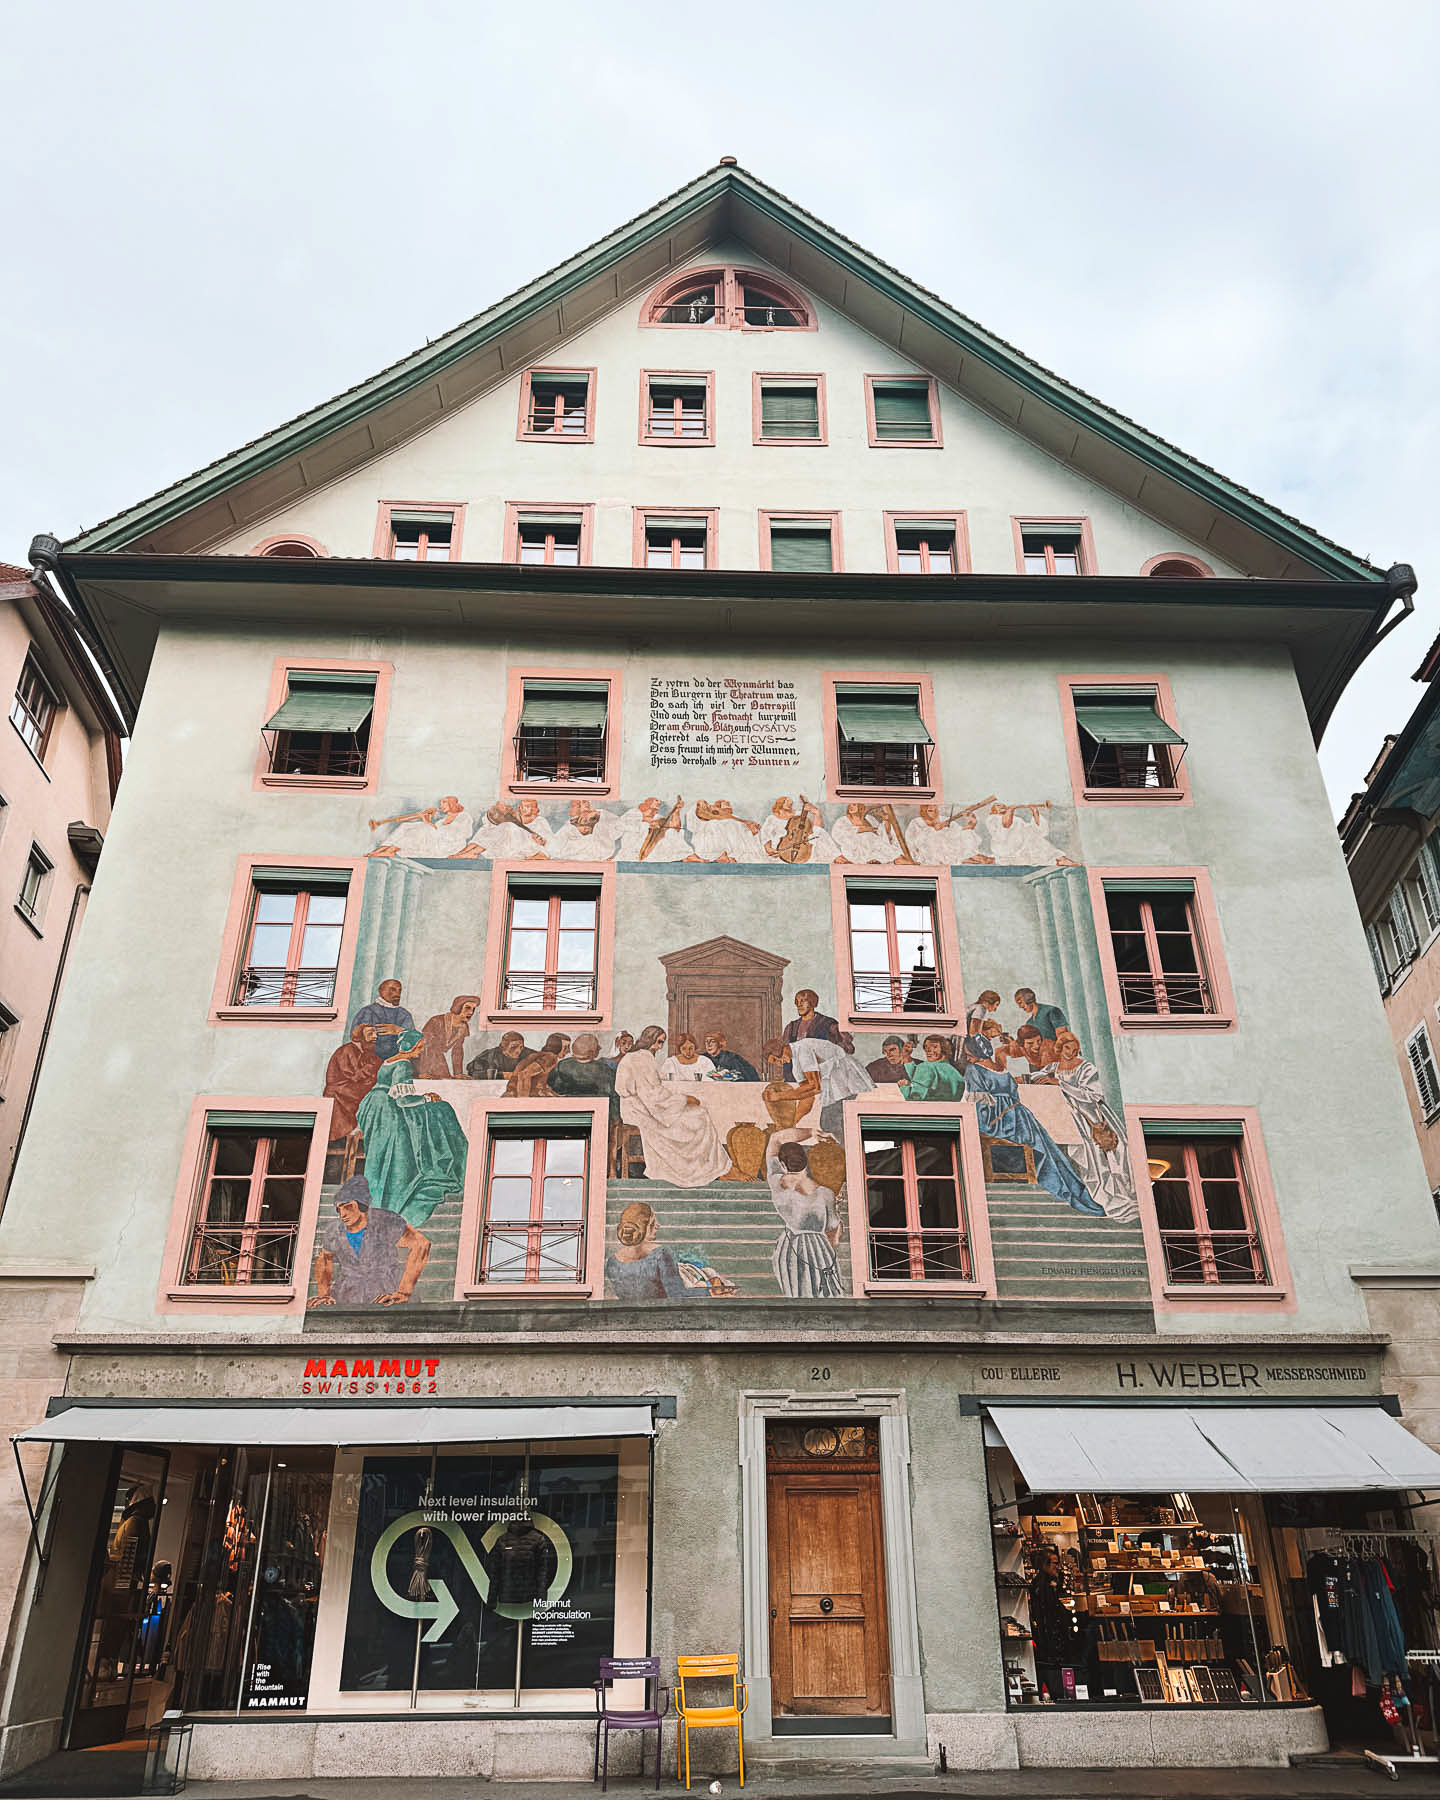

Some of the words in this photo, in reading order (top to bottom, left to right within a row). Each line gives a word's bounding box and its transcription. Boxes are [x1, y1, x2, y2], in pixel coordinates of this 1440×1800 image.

[693, 677, 705, 687] do
[706, 677, 721, 688] der
[650, 688, 668, 698] Den
[671, 688, 711, 700] Burgern
[714, 690, 727, 699] ihr
[730, 688, 774, 700] Theatrum
[650, 698, 664, 708] Do
[668, 700, 688, 711] sach
[692, 699, 704, 711] ich
[711, 701, 725, 709] viel
[730, 699, 746, 710] der
[650, 709, 669, 719] Und
[672, 711, 689, 721] ouch
[692, 710, 706, 720] der
[712, 710, 752, 723] Fastnacht
[649, 720, 666, 730] Der
[650, 731, 689, 744] Agieredt
[696, 733, 709, 742] als
[649, 742, 675, 753] Dess
[705, 744, 715, 754] ich
[717, 744, 733, 756] mich
[735, 744, 748, 754] der
[751, 744, 799, 755] Wunnen,
[651, 754, 677, 768] Heiss
[681, 755, 717, 768] derohalb
[303, 1359, 440, 1377] MAMMUT
[811, 1367, 831, 1380] 20
[1266, 1367, 1367, 1381] MESSERSCHMIED
[1116, 1363, 1144, 1388] H.
[1149, 1363, 1262, 1388] WEBER
[302, 1382, 376, 1394] SWISS
[383, 1382, 437, 1394] 1862
[418, 1495, 447, 1507] Next
[449, 1495, 477, 1506] level
[480, 1495, 538, 1506] insulation
[423, 1511, 448, 1522] with
[451, 1511, 485, 1522] lower
[487, 1510, 531, 1523] impact.
[532, 1598, 571, 1608] Mammut
[256, 1663, 272, 1671] Rise
[248, 1696, 306, 1707] MAMMUT
